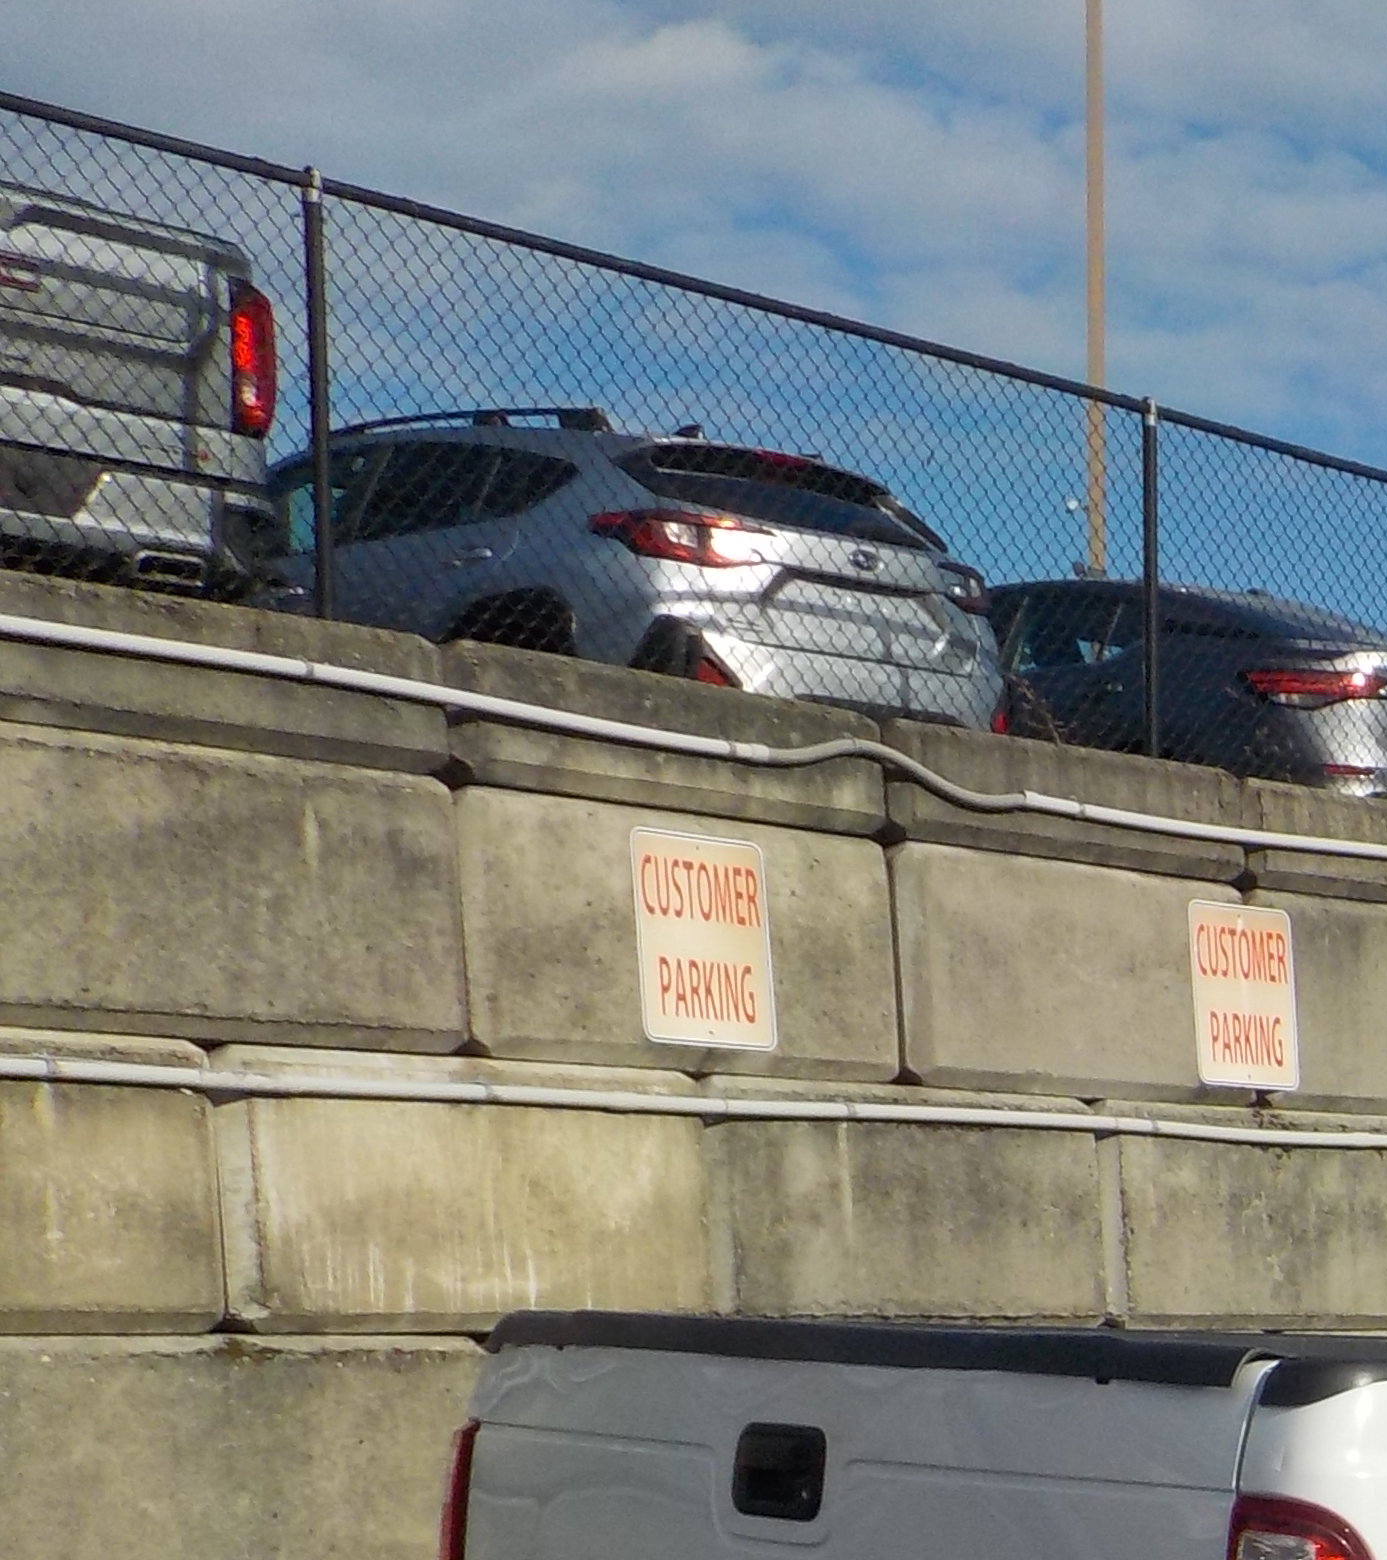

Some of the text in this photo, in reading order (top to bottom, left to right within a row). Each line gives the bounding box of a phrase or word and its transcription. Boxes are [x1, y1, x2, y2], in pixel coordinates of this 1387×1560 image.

[641, 853, 761, 929] CUSTOMER
[1195, 922, 1289, 986] CUSTOMER
[657, 954, 759, 1026] PARKING
[1208, 1010, 1286, 1069] PARKING
